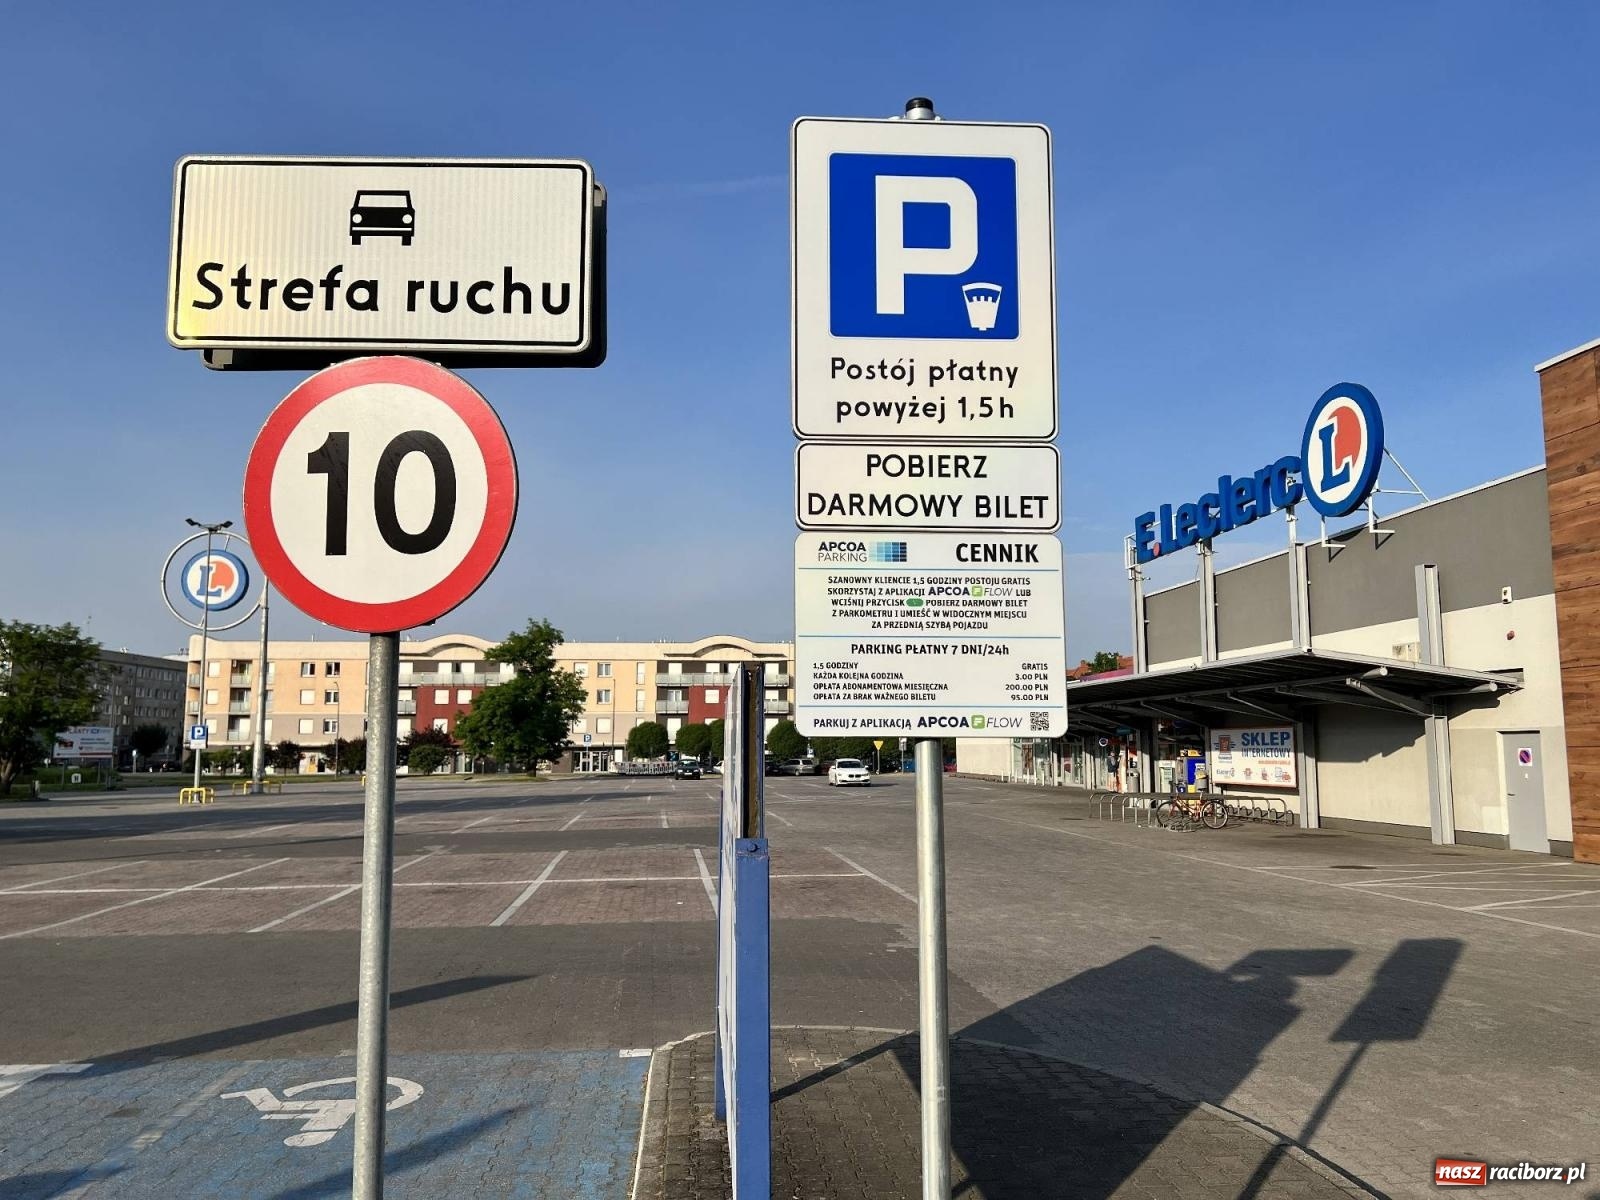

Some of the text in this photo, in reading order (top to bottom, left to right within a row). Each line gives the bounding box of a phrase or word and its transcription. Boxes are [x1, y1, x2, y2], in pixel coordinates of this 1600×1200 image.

[875, 175, 978, 314] P
[192, 262, 570, 314] Strefa ruchu
[831, 357, 1018, 388] Postój płatny
[837, 396, 945, 423] powyżej
[866, 453, 988, 478] POBIERZ
[307, 430, 456, 555] 10
[1135, 422, 1350, 564] E.Leclerc L
[808, 492, 1048, 518] DARMOWY BILET
[818, 542, 866, 552] APCOA
[956, 543, 1039, 563] CENNIK
[818, 552, 867, 562] PARKING
[197, 565, 223, 597] L
[828, 576, 1031, 586] SZANOWNY KLIENCIE 1,5 GODZINY POSTOJU GRATIS
[827, 586, 1031, 597] SKORZYSTAJ Z APLIKACJI APCOA FLOW LUB
[831, 598, 1028, 607] WCIŚNIJ PRZYCISK POBIERZ DARMOWY BILET
[832, 609, 837, 617] Z
[839, 609, 893, 618] PARKOMETRU
[900, 608, 931, 618] UMIEŚĆ
[932, 610, 941, 618] W
[942, 610, 992, 618] WIDOCZNYM
[994, 610, 1027, 619] MIEJSCU
[871, 621, 988, 631] ZA PRZEDNIĄ SZYBĄ POJAZDU
[851, 643, 1009, 656] PARKING PŁATNY 7 DNI/24h
[813, 661, 1048, 670] 1,5 GODZINY GRATIS
[813, 671, 837, 680] KAŻDA
[838, 672, 869, 680] KOLEJNA
[871, 672, 904, 680] GODZINA
[1015, 673, 1033, 681] 3.00
[813, 682, 841, 690] OPŁATA
[842, 682, 902, 691] ABONAMENTOWA
[904, 683, 948, 692] MIESIĘCZNA
[874, 691, 909, 700] WAŻNEGO
[813, 716, 1023, 730] PARKUJ Z APLIKACJĄ APCOA FLOW
[1241, 731, 1290, 746] SKLEP
[1241, 747, 1291, 758] INTERNETOWY
